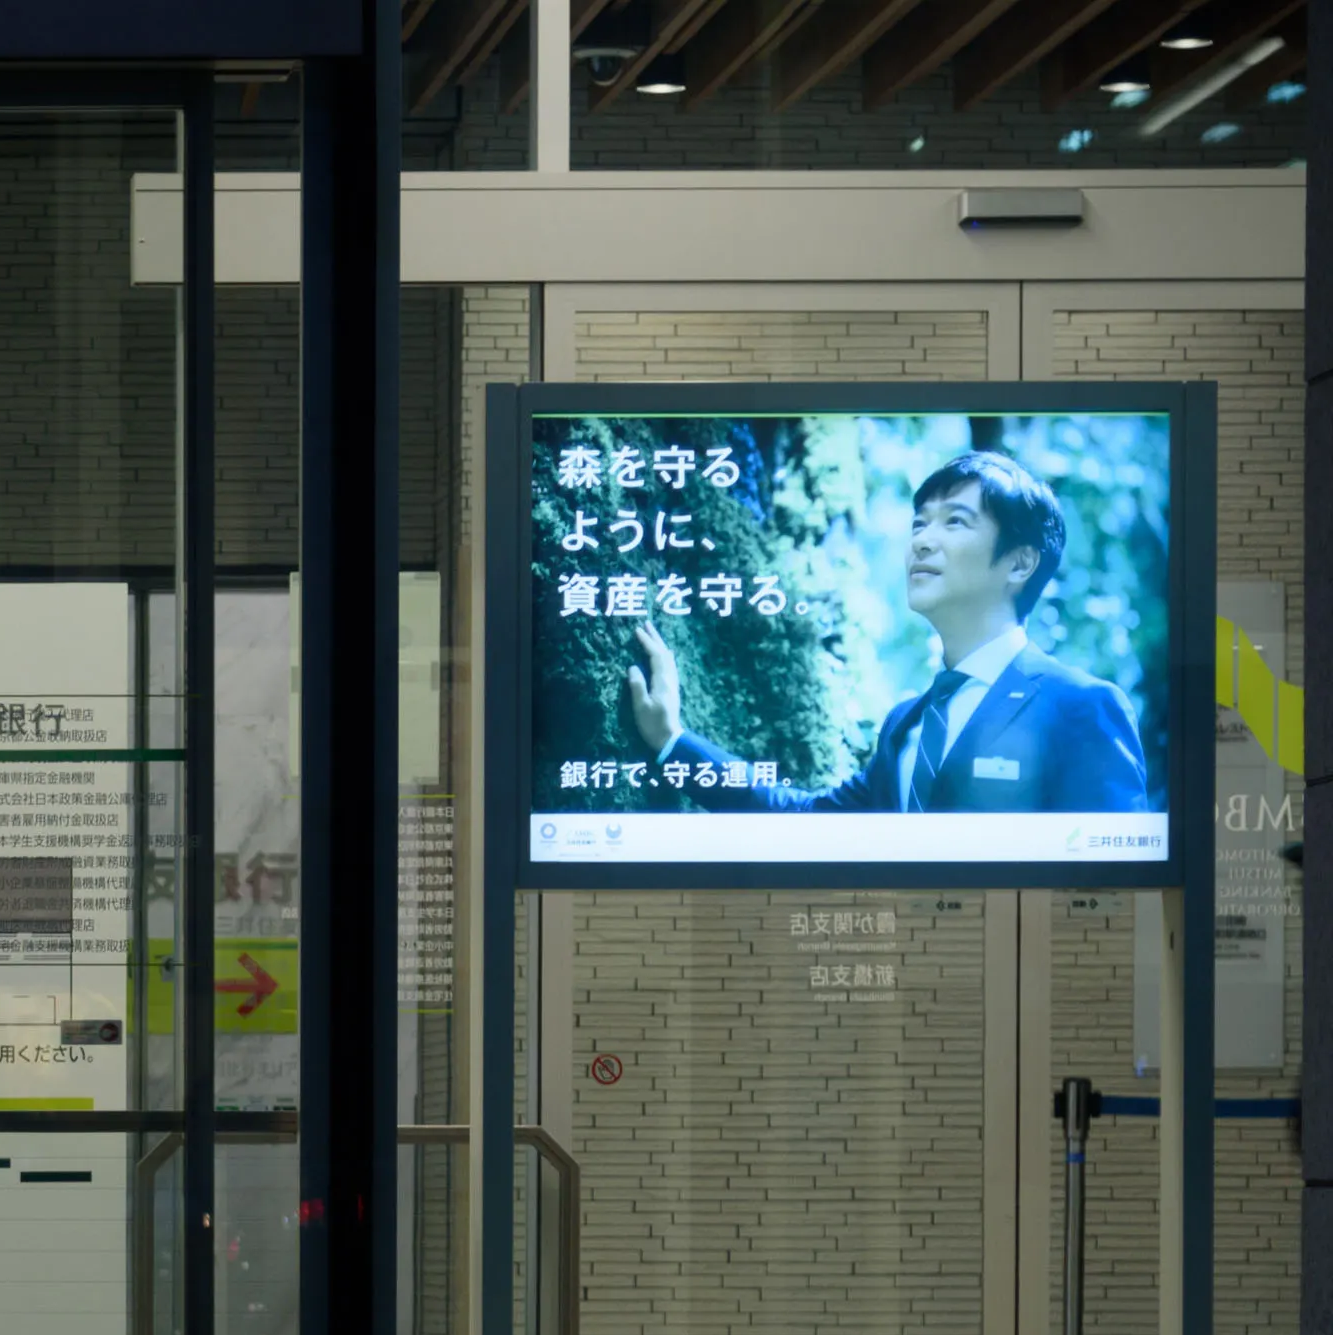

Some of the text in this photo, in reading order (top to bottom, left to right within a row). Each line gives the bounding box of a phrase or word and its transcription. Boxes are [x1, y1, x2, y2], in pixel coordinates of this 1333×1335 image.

[558, 445, 740, 489] 森を守る
[561, 509, 715, 552] ように、
[558, 572, 809, 617] 資産を守る。
[560, 760, 792, 789] 銀行で、守る運用。
[1088, 835, 1161, 848] 三井住友銀行
